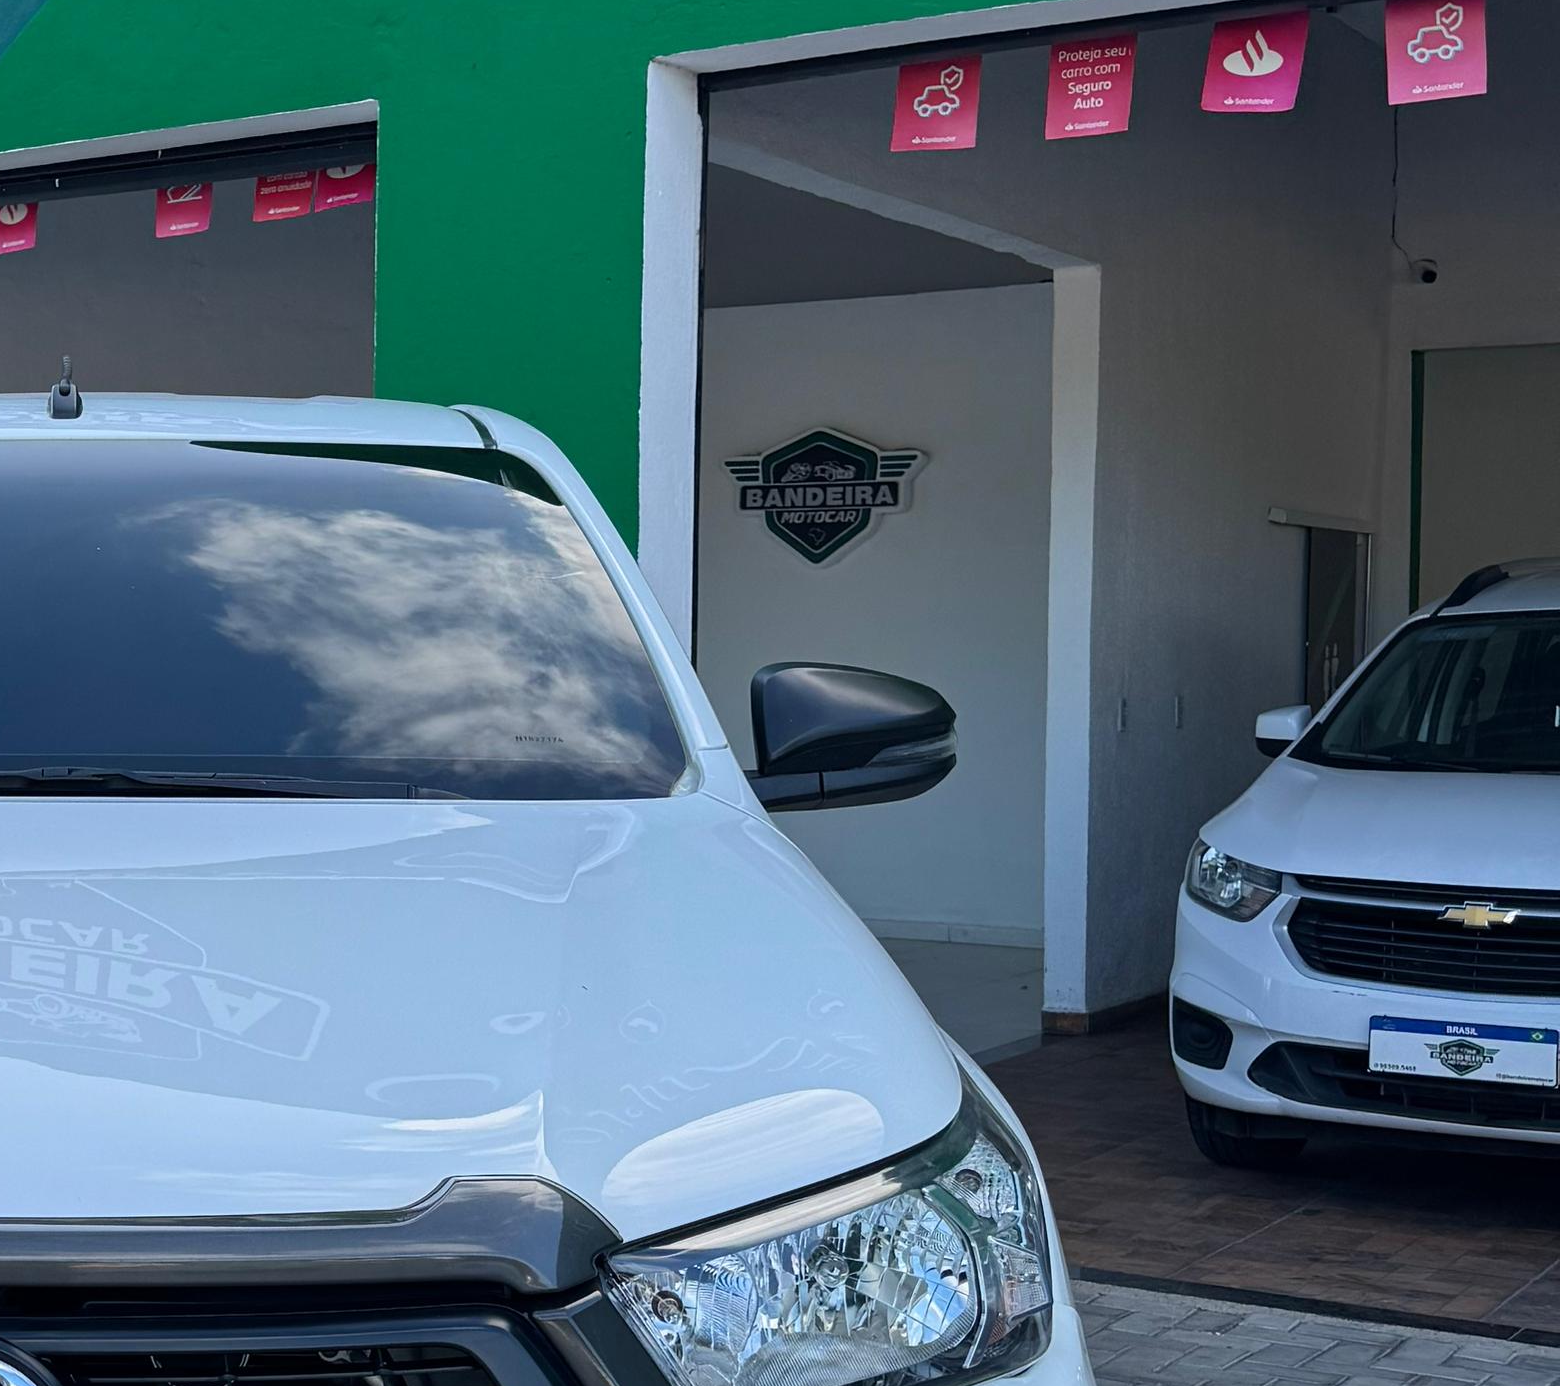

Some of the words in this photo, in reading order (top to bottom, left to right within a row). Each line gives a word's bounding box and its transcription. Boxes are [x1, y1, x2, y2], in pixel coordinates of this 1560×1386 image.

[1058, 46, 1102, 63] Proteja
[1104, 47, 1127, 59] seu
[1061, 65, 1092, 79] carro
[1094, 63, 1121, 76] com
[1067, 80, 1112, 96] Seguro
[1423, 81, 1464, 93] Santander
[1073, 97, 1104, 110] Auto
[1235, 96, 1275, 106] Santander
[1074, 119, 1110, 130] Santander
[921, 134, 957, 144] Santander
[746, 484, 894, 508] BANDEIRA
[780, 510, 857, 524] MOTOCAR
[1446, 1025, 1478, 1036] BRASIL
